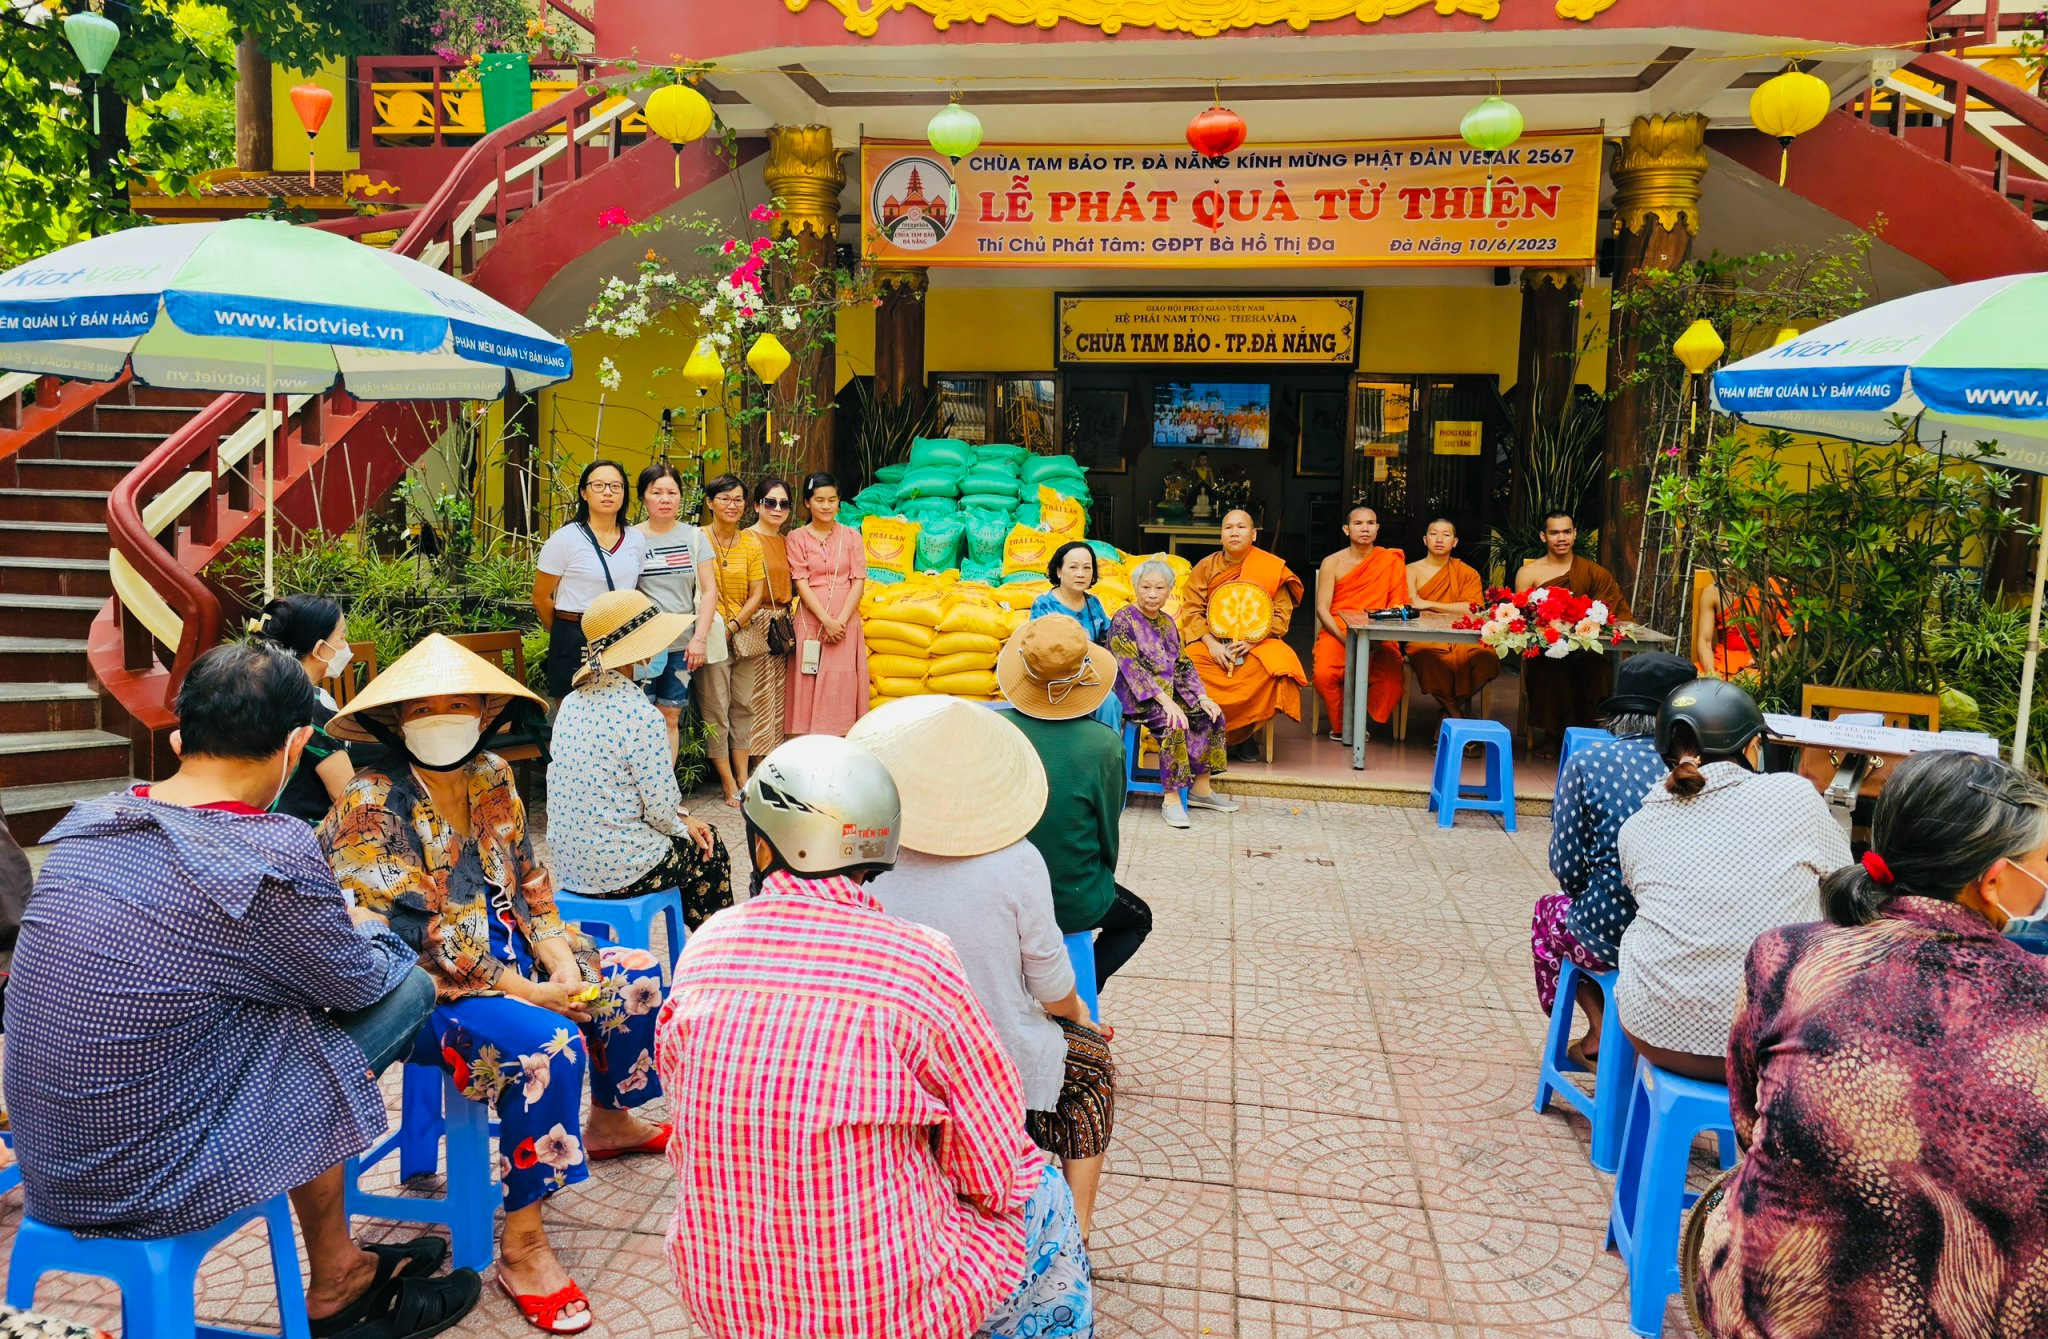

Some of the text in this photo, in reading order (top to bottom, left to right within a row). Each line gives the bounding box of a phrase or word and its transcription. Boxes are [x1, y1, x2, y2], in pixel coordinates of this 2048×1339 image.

[969, 154, 1020, 171] CHÙA
[1027, 157, 1062, 170] TAM
[1069, 153, 1107, 170] BẢO
[1113, 157, 1135, 170] TP.
[1142, 153, 1168, 170] ĐÀ
[1237, 151, 1282, 168] KÍNH
[1288, 152, 1348, 168] MỪNG
[1354, 149, 1404, 171] PHẬT
[1409, 147, 1452, 166] ĐẢN
[1527, 149, 1575, 164] 2567
[978, 174, 1561, 229] LỄ PHÁT QUÀ TỪ THIỆN
[978, 233, 1335, 255] Thí Chủ Phát Tâm: GĐPT Bà Hồ Thị Đa
[1390, 236, 1557, 254] Đà Nẵng 10/6/2023
[2, 263, 162, 288] KiotViet
[62, 312, 77, 327] LÝ
[80, 310, 108, 326] BÁN
[214, 310, 404, 341] www.kiotviet.vn
[1115, 313, 1130, 324] HỆ
[1134, 313, 1160, 322] PHÁI
[1076, 328, 1126, 352] CHÙA
[1130, 333, 1169, 352] TAM
[1173, 328, 1211, 352] BẢO
[1282, 326, 1337, 352] NẴNG
[1769, 334, 1923, 358] KiotViet
[1812, 383, 1827, 398] LÝ
[1965, 388, 2048, 407] www.
[1064, 505, 1078, 515] LAN
